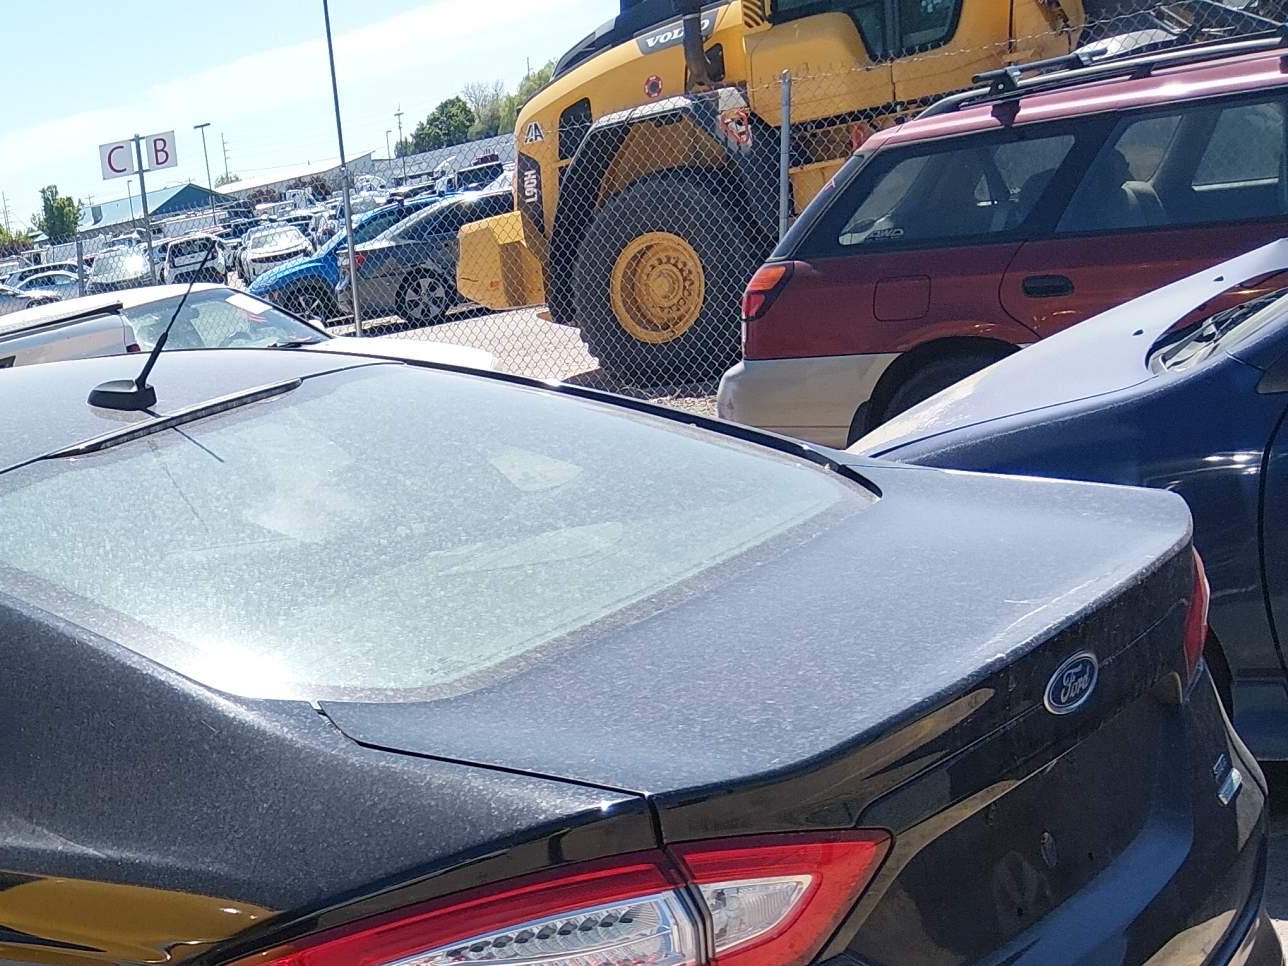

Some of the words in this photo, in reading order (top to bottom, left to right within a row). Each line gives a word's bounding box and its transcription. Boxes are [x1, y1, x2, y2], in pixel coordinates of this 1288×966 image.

[645, 19, 710, 48] VOLO
[107, 145, 127, 173] C
[153, 138, 169, 165] B
[1061, 663, 1091, 704] Ford
